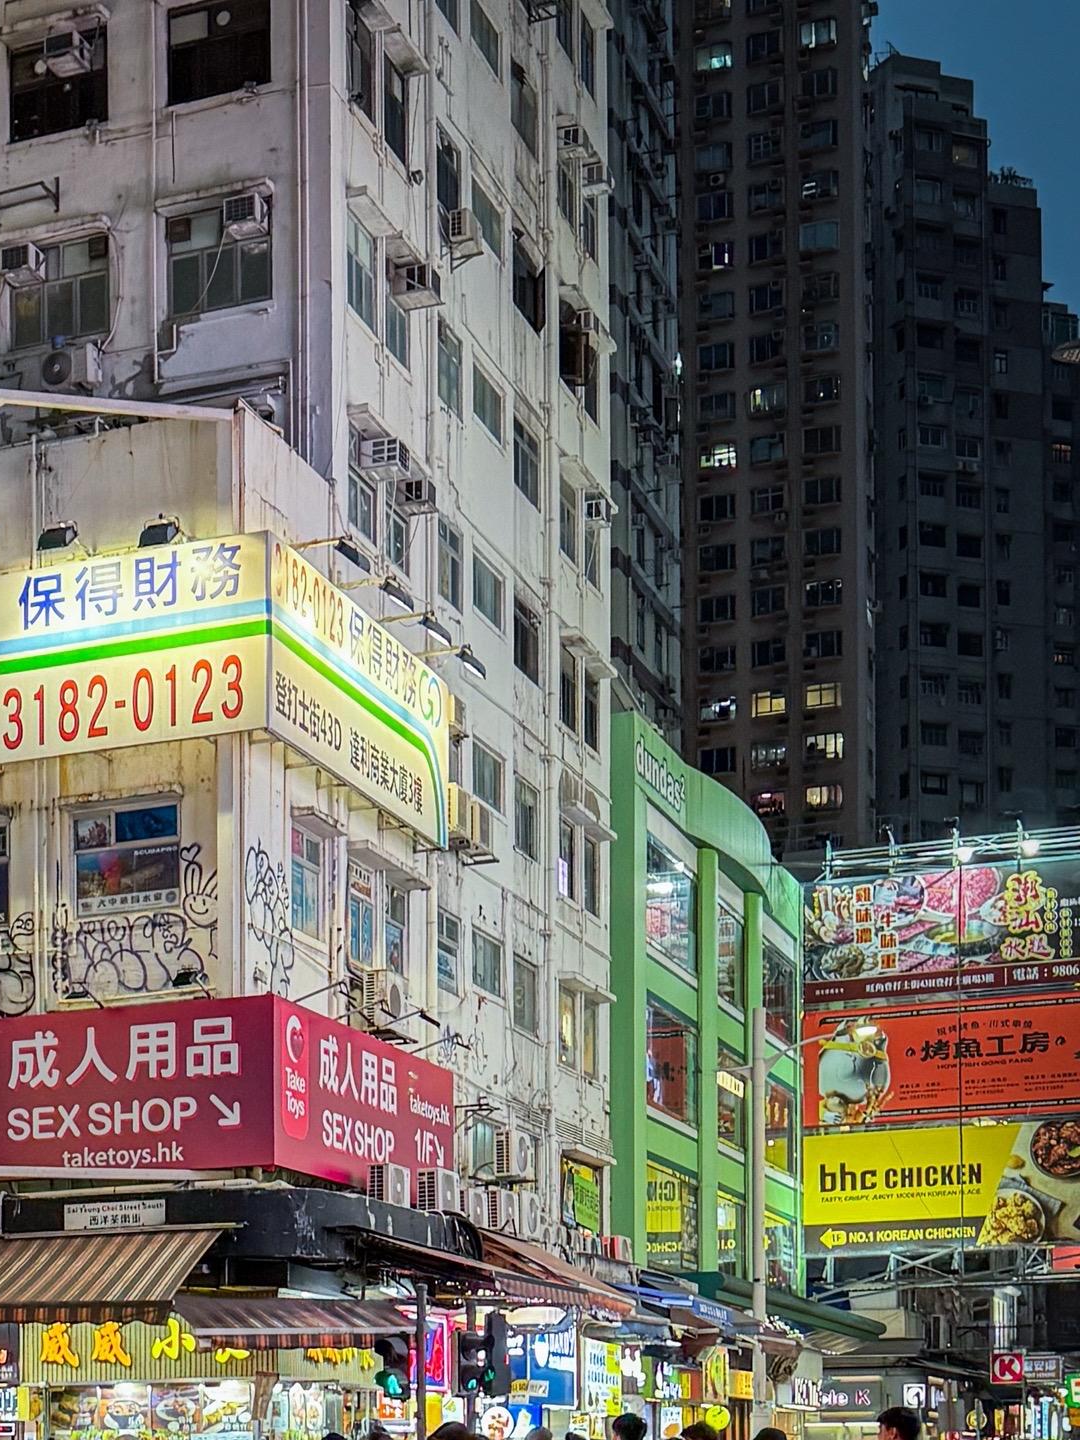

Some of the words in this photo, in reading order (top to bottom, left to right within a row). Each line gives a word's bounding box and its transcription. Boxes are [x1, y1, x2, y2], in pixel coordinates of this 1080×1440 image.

[18, 542, 242, 631] 保得財務
[274, 542, 344, 650] 3182-0123
[348, 605, 418, 709] 保得財務
[2, 653, 246, 751] 3182-0123
[274, 669, 343, 752] 登打士街43D
[8, 1016, 242, 1091] 成人用品
[919, 1030, 1050, 1062] 烤魚工房
[285, 1066, 306, 1094] Take
[318, 1034, 398, 1116] 成人用品
[7, 1105, 80, 1142] SEX
[87, 1097, 198, 1136] SHOP
[285, 1090, 306, 1120] Toys
[409, 1092, 451, 1127] taketoys.hk
[62, 1142, 185, 1168] taketoys.hk
[322, 1109, 353, 1156] SEX
[354, 1120, 395, 1163] SHOP
[819, 1162, 878, 1193] bhc
[884, 1163, 982, 1190] CHICKEN
[848, 1230, 874, 1244] NO.1
[876, 1229, 923, 1242] KOREAN
[925, 1226, 976, 1241] CHICKEN
